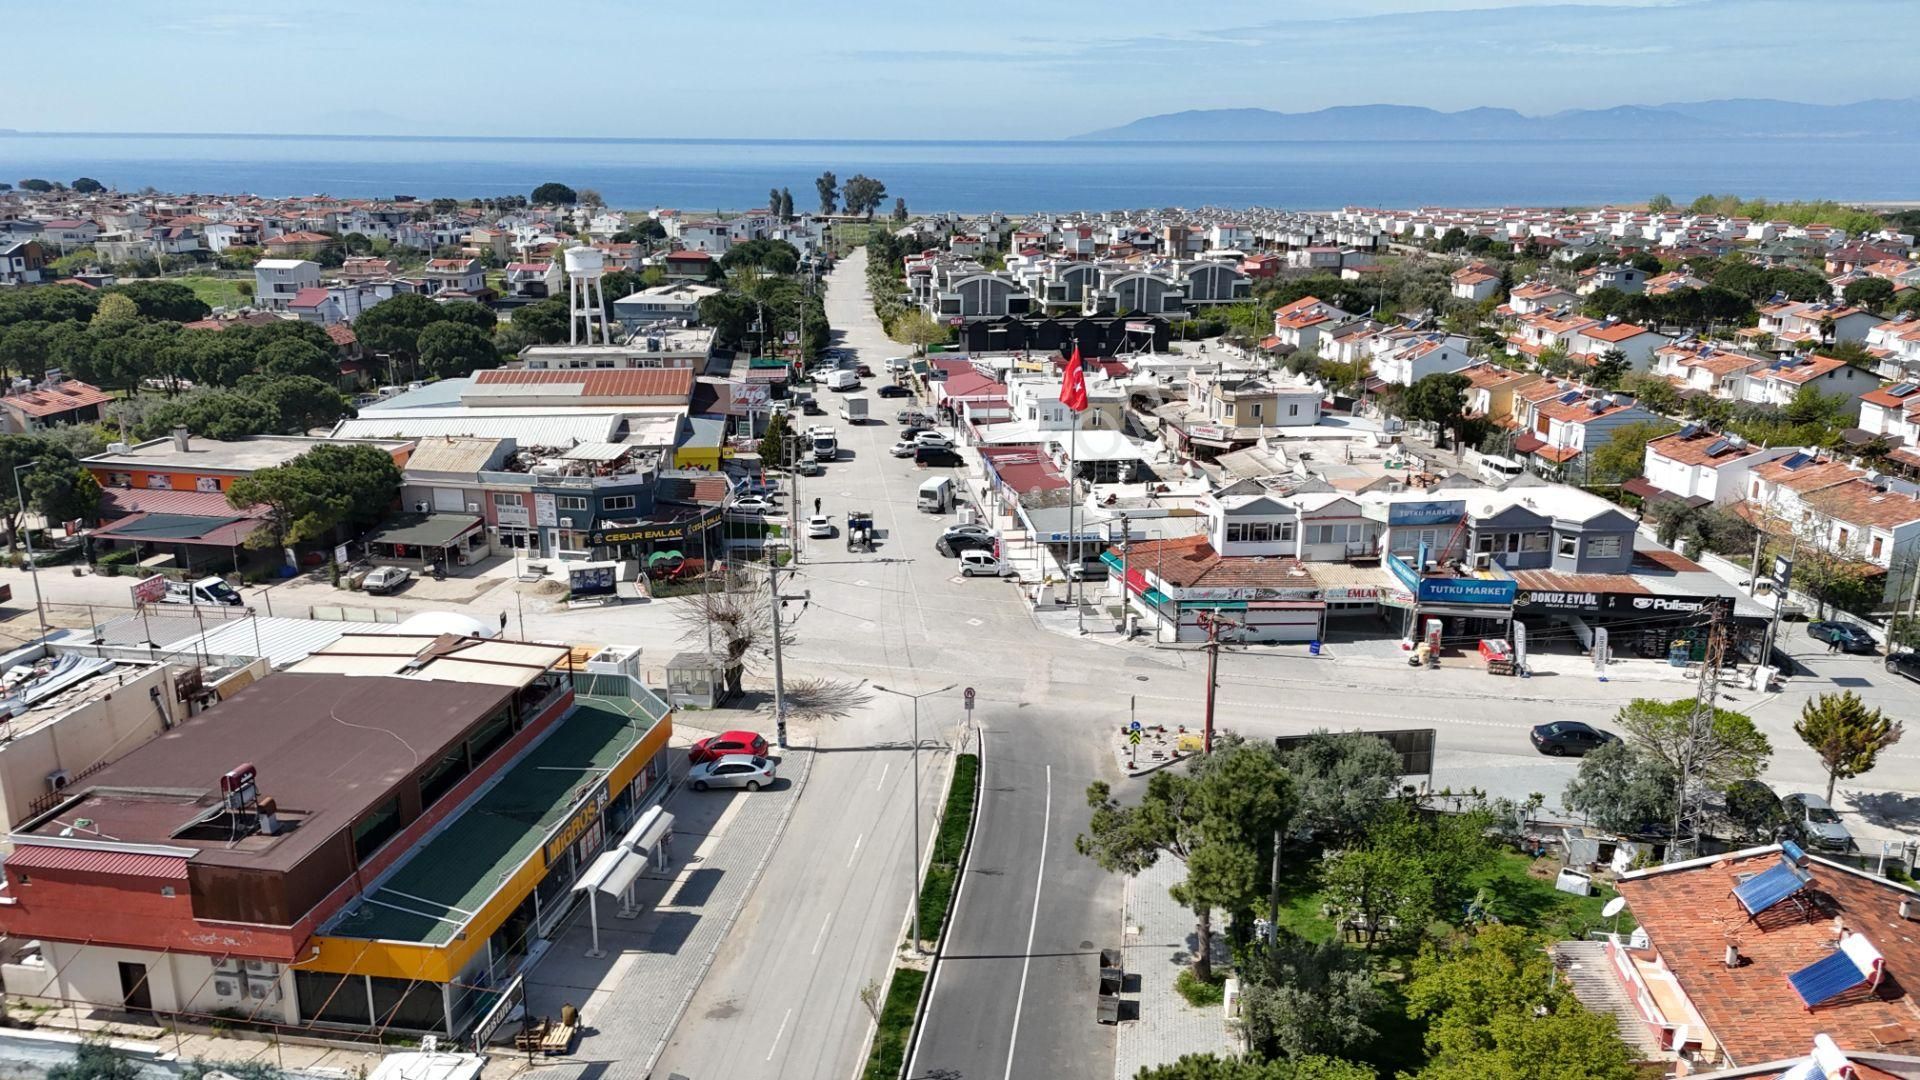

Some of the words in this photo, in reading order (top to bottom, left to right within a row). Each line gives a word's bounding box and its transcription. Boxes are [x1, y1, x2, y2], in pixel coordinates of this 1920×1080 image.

[1399, 509, 1425, 518] TUTKU
[1427, 508, 1457, 517] MARKET
[605, 531, 643, 542] CESUR
[644, 528, 683, 540] EMLAK
[1347, 588, 1379, 598] EMLAK
[1430, 585, 1463, 595] TUTKU
[1465, 586, 1507, 596] MARKET
[1530, 591, 1565, 604] DOKUZ
[1653, 598, 1703, 611] Polisan
